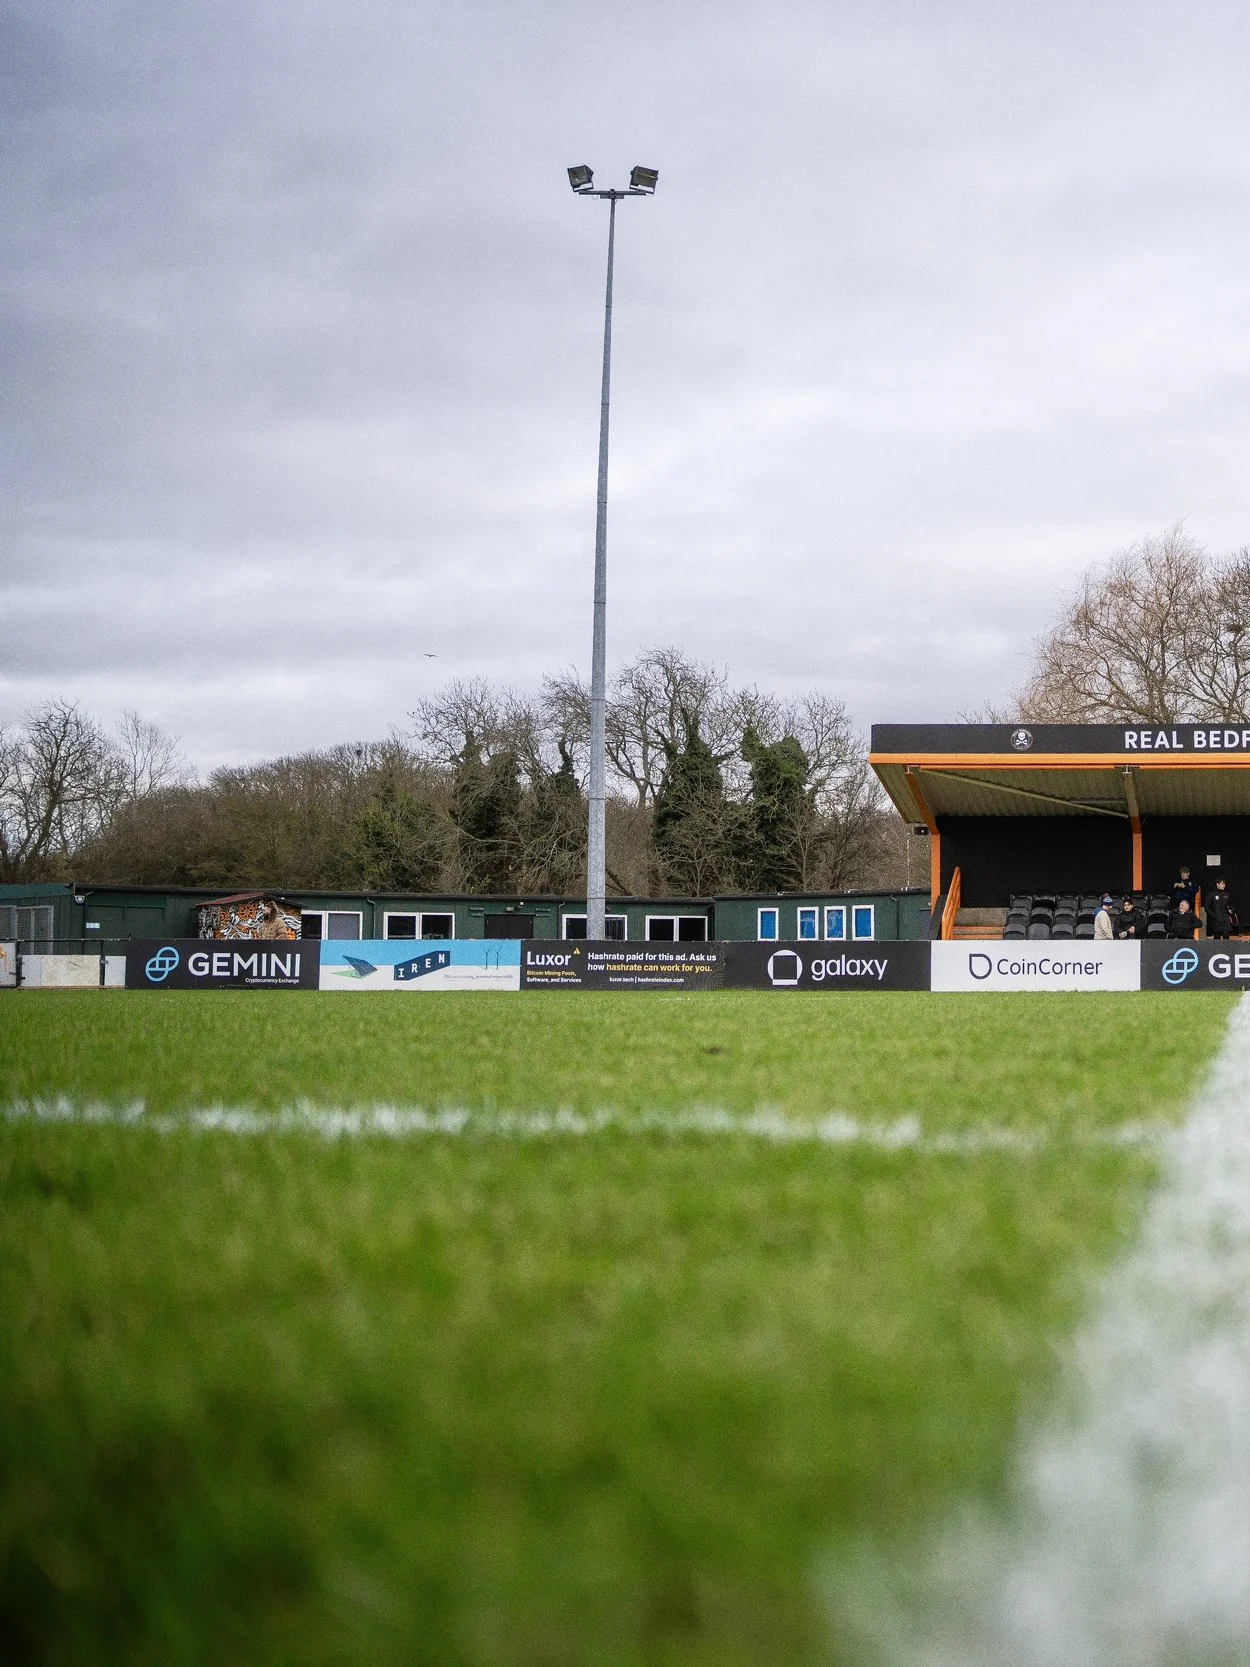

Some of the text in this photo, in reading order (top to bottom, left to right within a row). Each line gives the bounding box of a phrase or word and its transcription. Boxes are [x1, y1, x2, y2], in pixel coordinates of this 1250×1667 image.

[1124, 731, 1184, 749] REAL
[188, 952, 301, 977] GEMINI
[398, 953, 445, 978] IREN
[526, 951, 572, 966] Luxor
[588, 952, 625, 960] Hashrate
[626, 952, 644, 962] paid
[645, 952, 658, 960] for
[658, 952, 674, 961] this
[588, 962, 605, 970] how
[606, 963, 642, 971] hashrate
[682, 964, 694, 972] for
[695, 965, 713, 974] you.
[811, 954, 888, 981] galaxy
[997, 958, 1102, 975] CoinCorner
